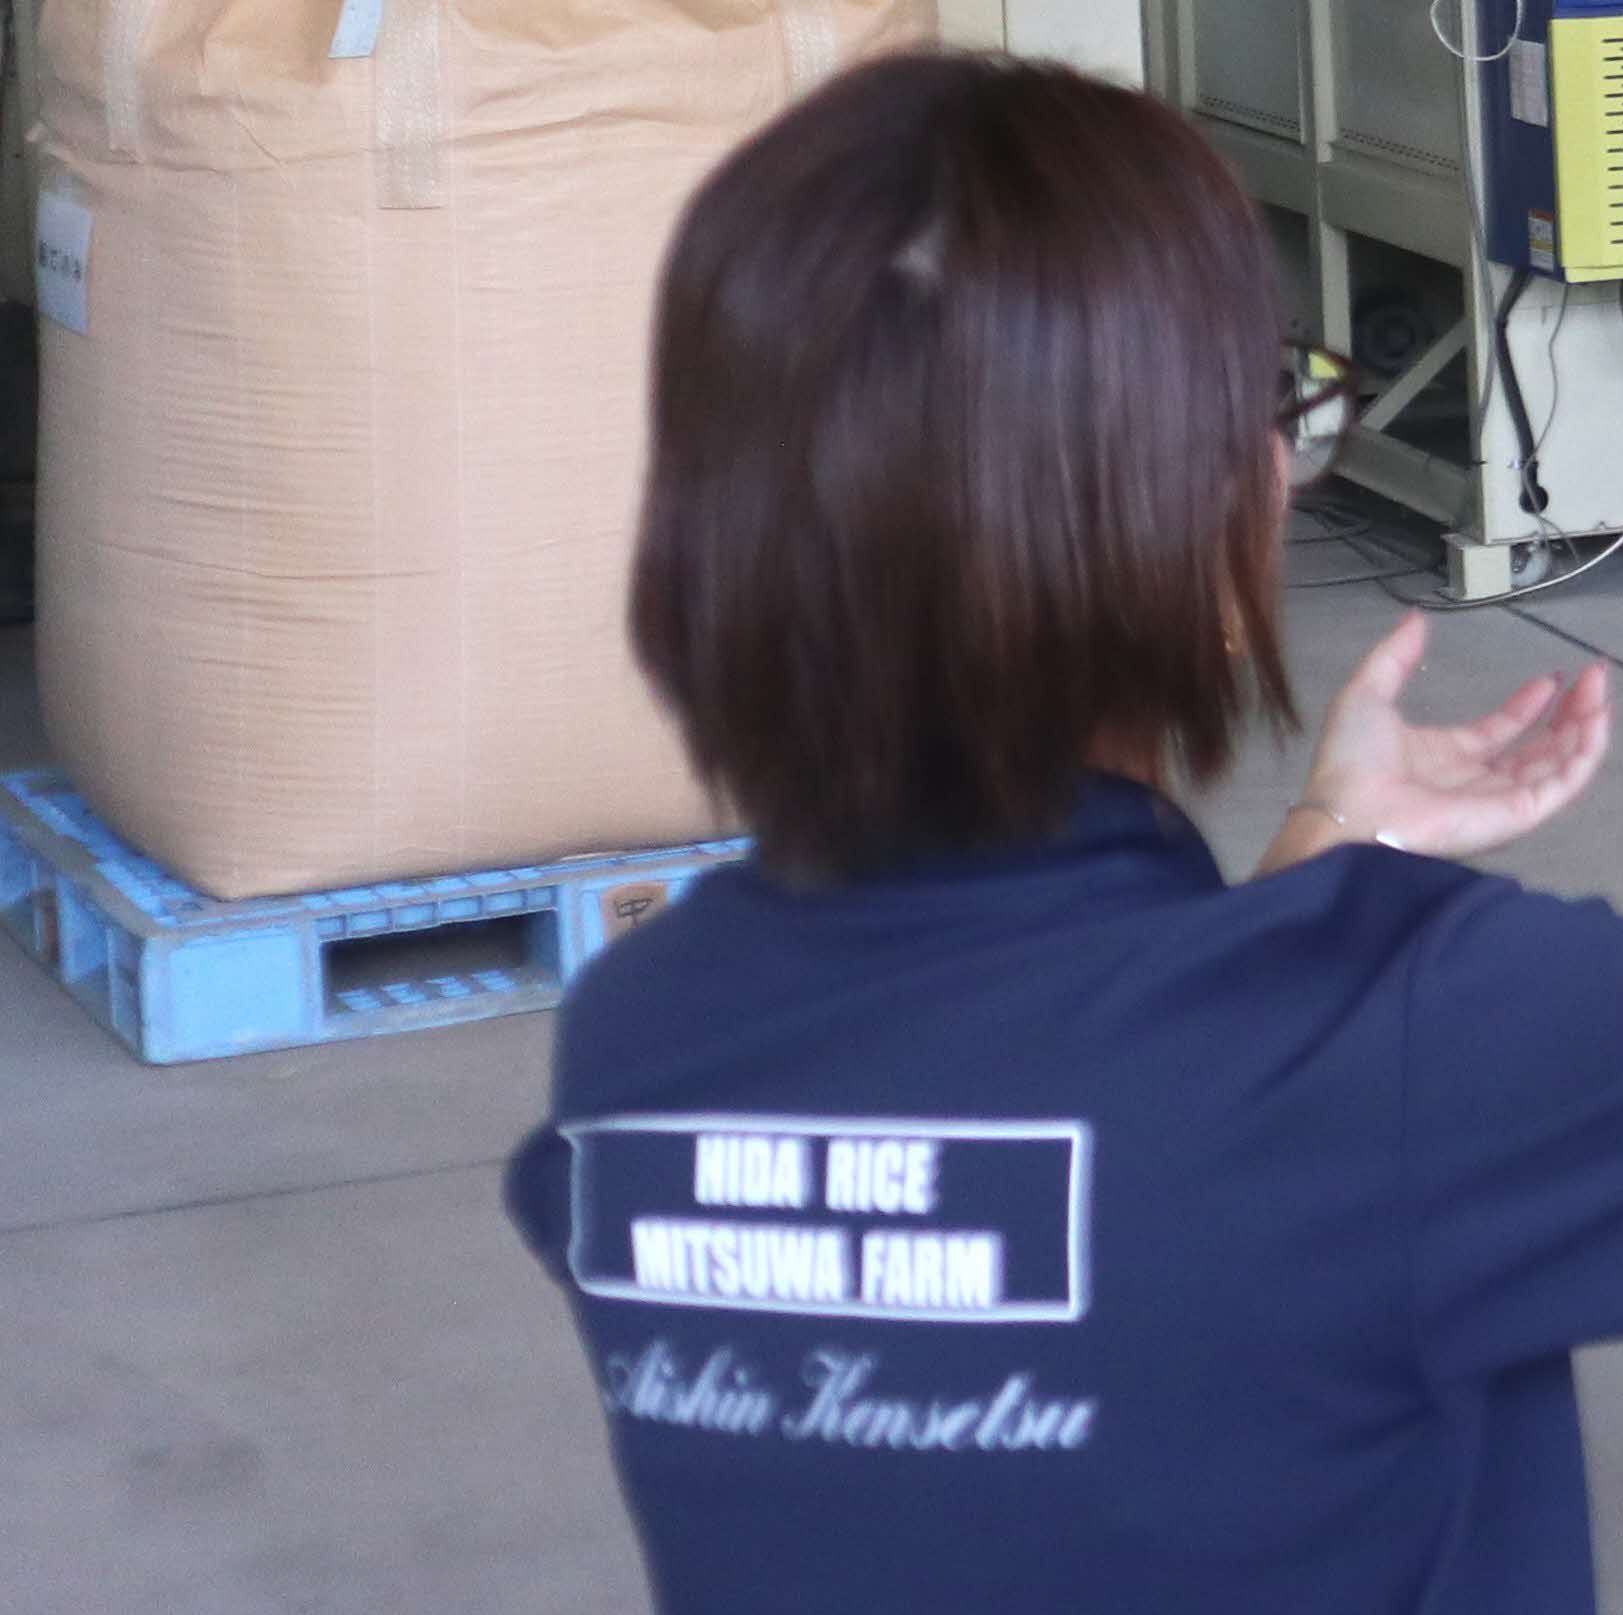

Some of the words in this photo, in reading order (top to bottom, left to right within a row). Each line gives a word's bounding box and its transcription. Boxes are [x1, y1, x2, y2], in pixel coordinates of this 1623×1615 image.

[825, 1139, 936, 1215] RICE
[633, 1222, 846, 1304] MITSUWA
[860, 1232, 1000, 1309] FARM
